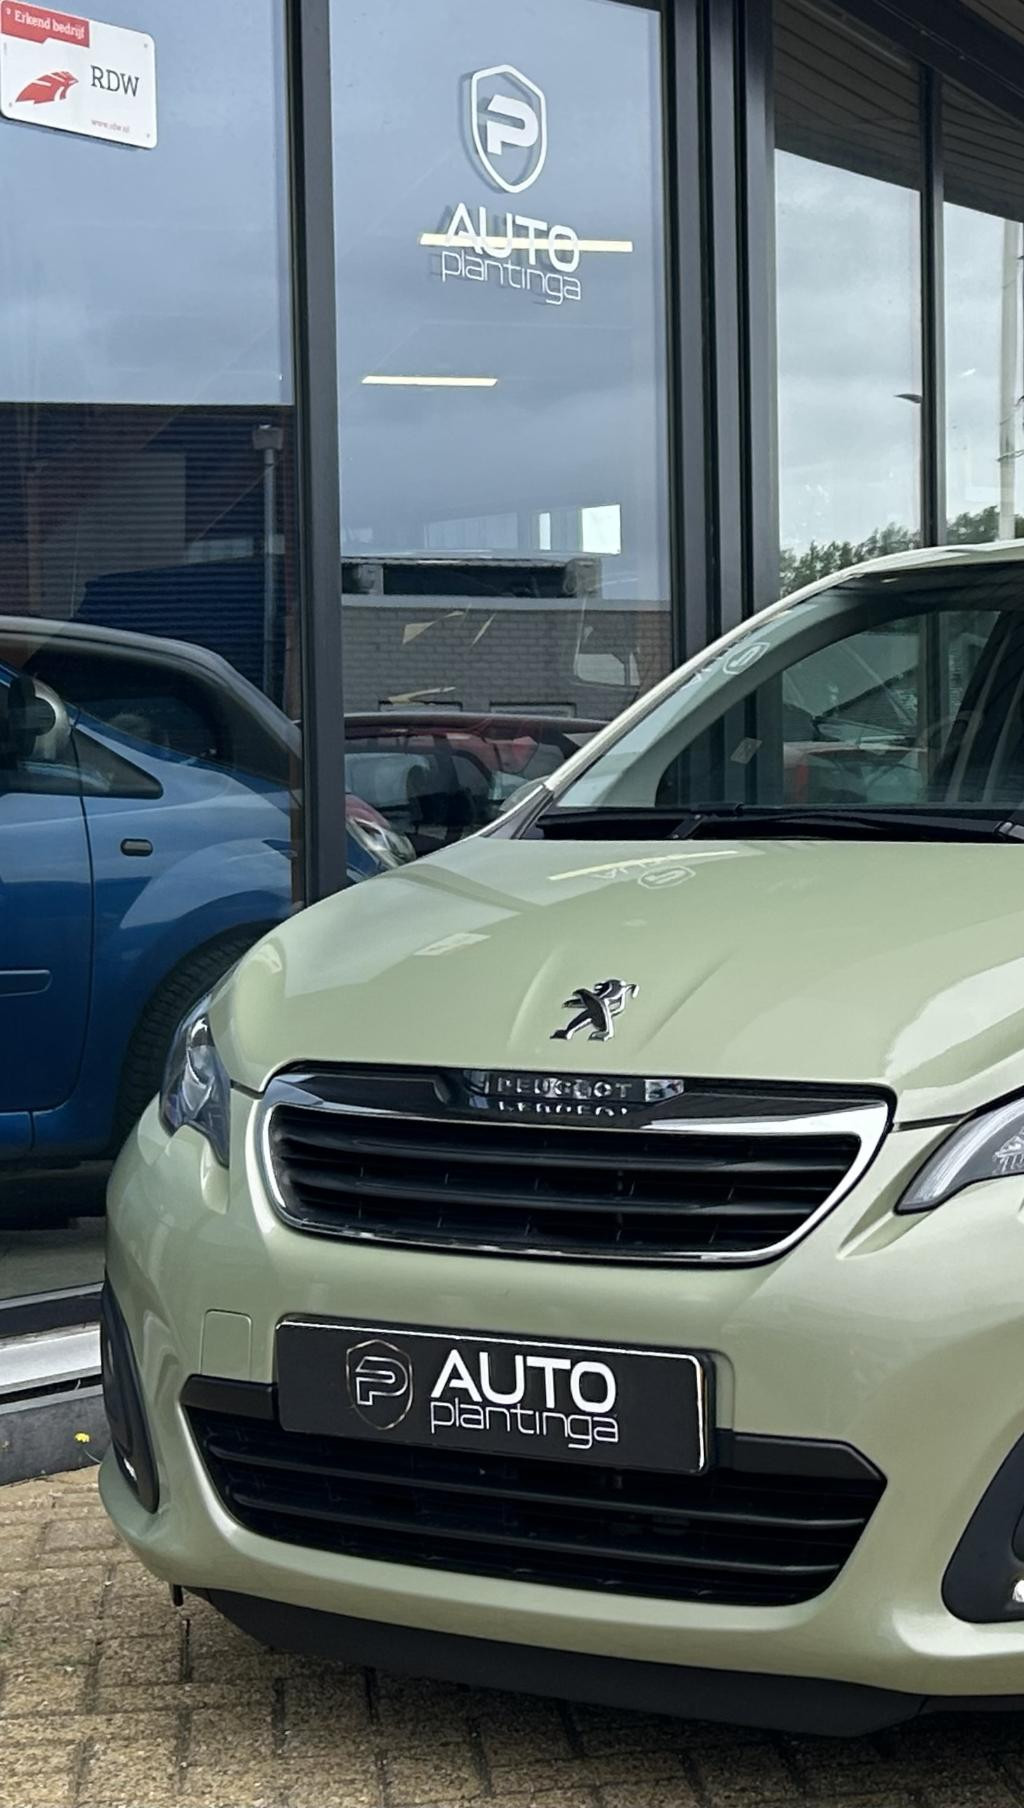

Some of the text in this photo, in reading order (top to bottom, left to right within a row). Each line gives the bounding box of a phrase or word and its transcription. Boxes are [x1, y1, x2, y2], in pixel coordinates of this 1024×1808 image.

[14, 10, 86, 39] Erkend bedrijf
[90, 64, 139, 97] RDW
[445, 202, 580, 273] AUTO
[442, 250, 582, 305] plantinga
[497, 1077, 632, 1100] PEUGEOT
[430, 1349, 617, 1413] AUTO
[430, 1397, 619, 1449] plantinga
